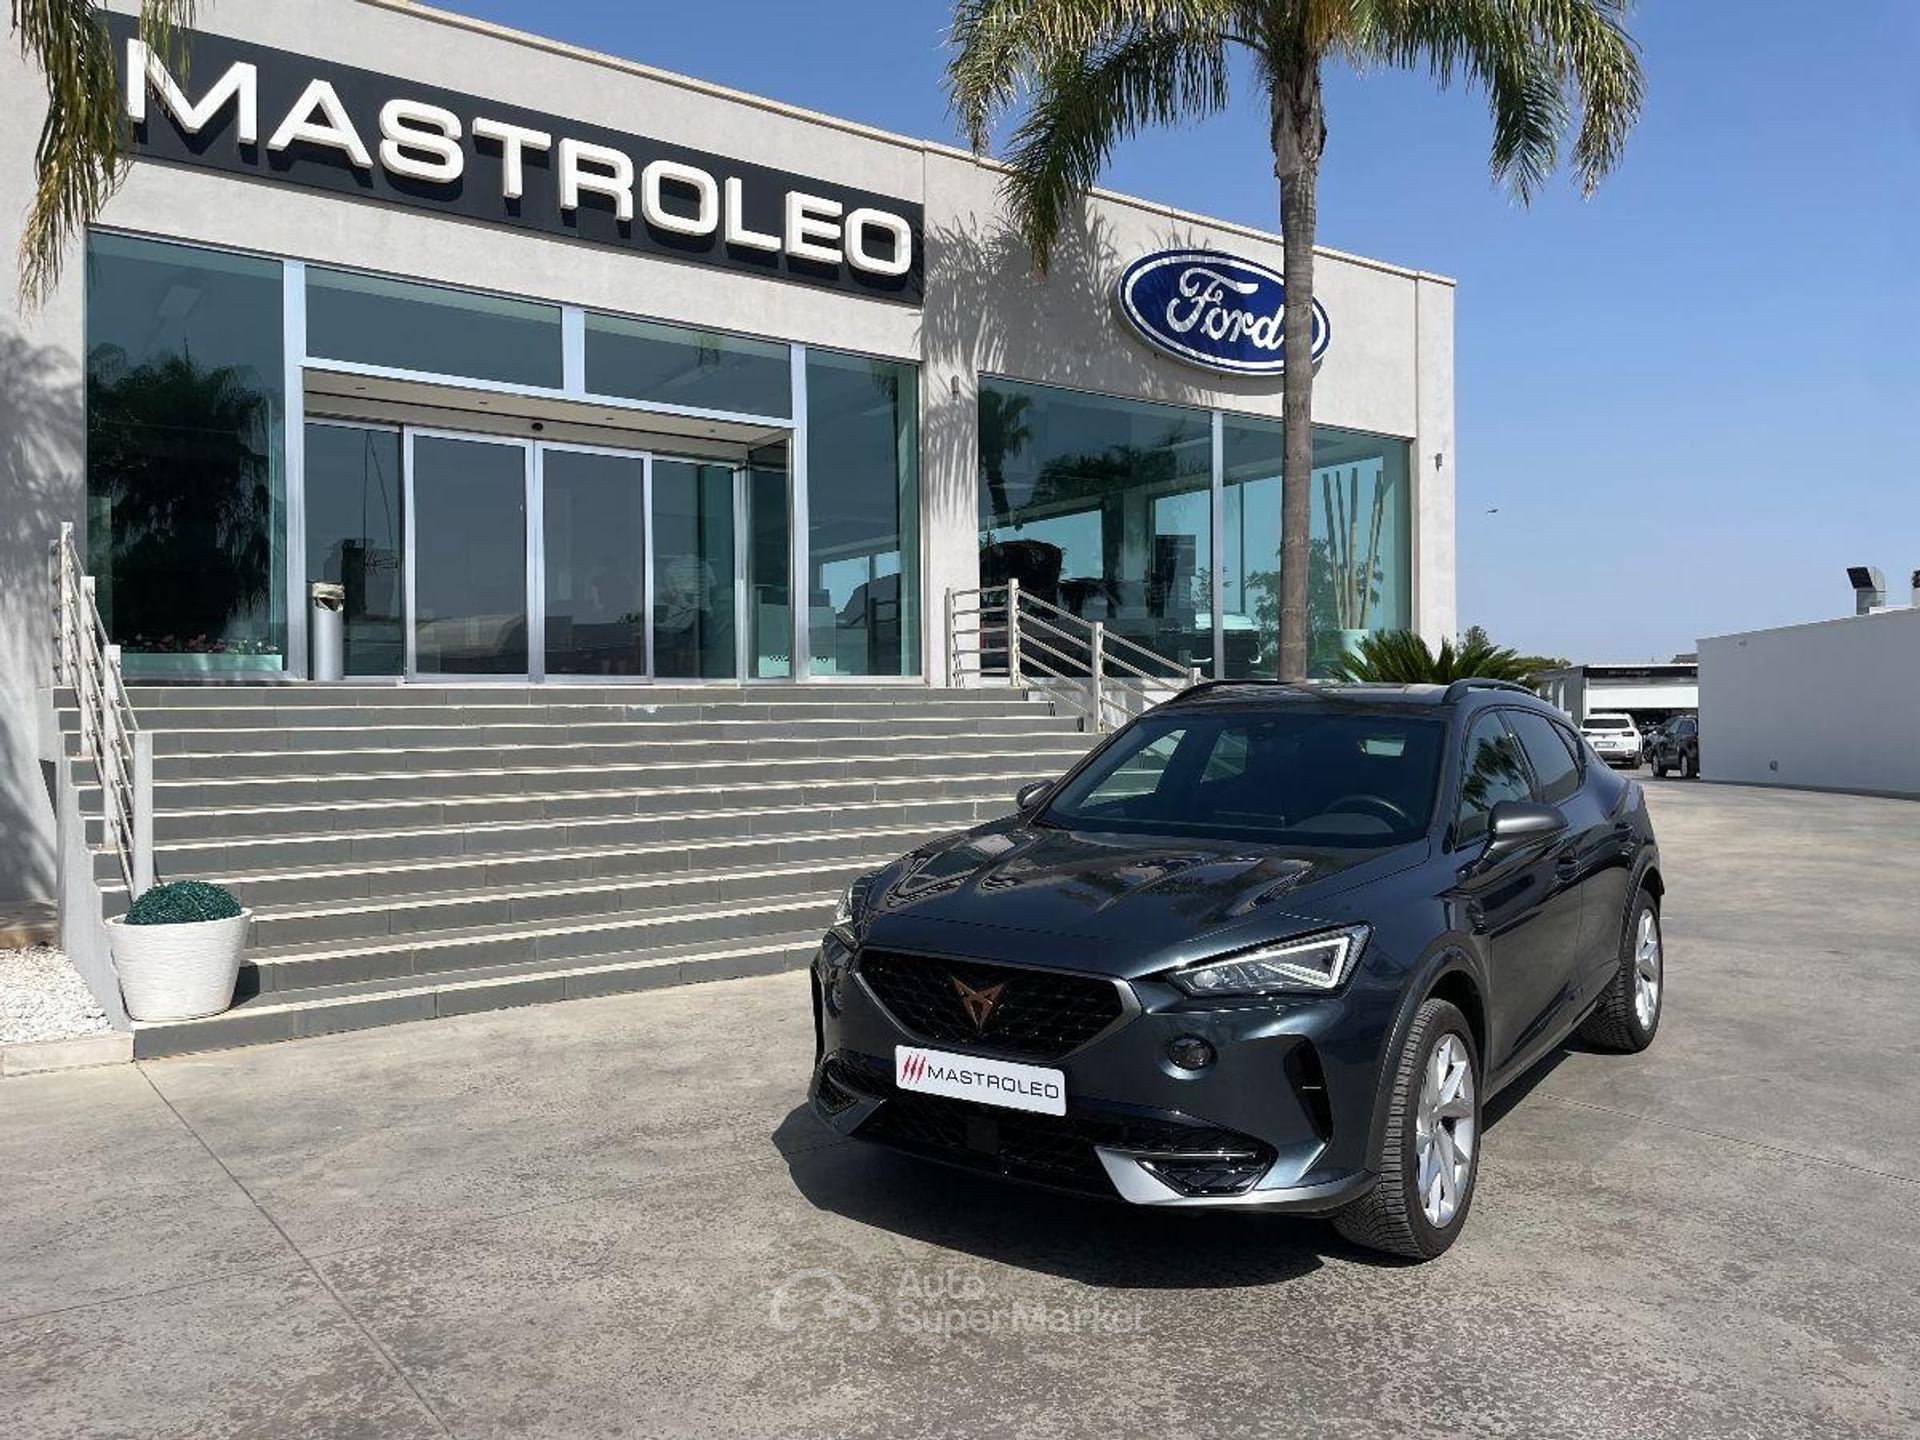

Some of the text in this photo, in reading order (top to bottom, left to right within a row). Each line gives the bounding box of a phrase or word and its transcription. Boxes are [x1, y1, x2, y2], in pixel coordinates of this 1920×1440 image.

[126, 38, 913, 277] MASTROLEO
[1166, 267, 1285, 350] Ford
[927, 1064, 1059, 1099] MASTROLEO
